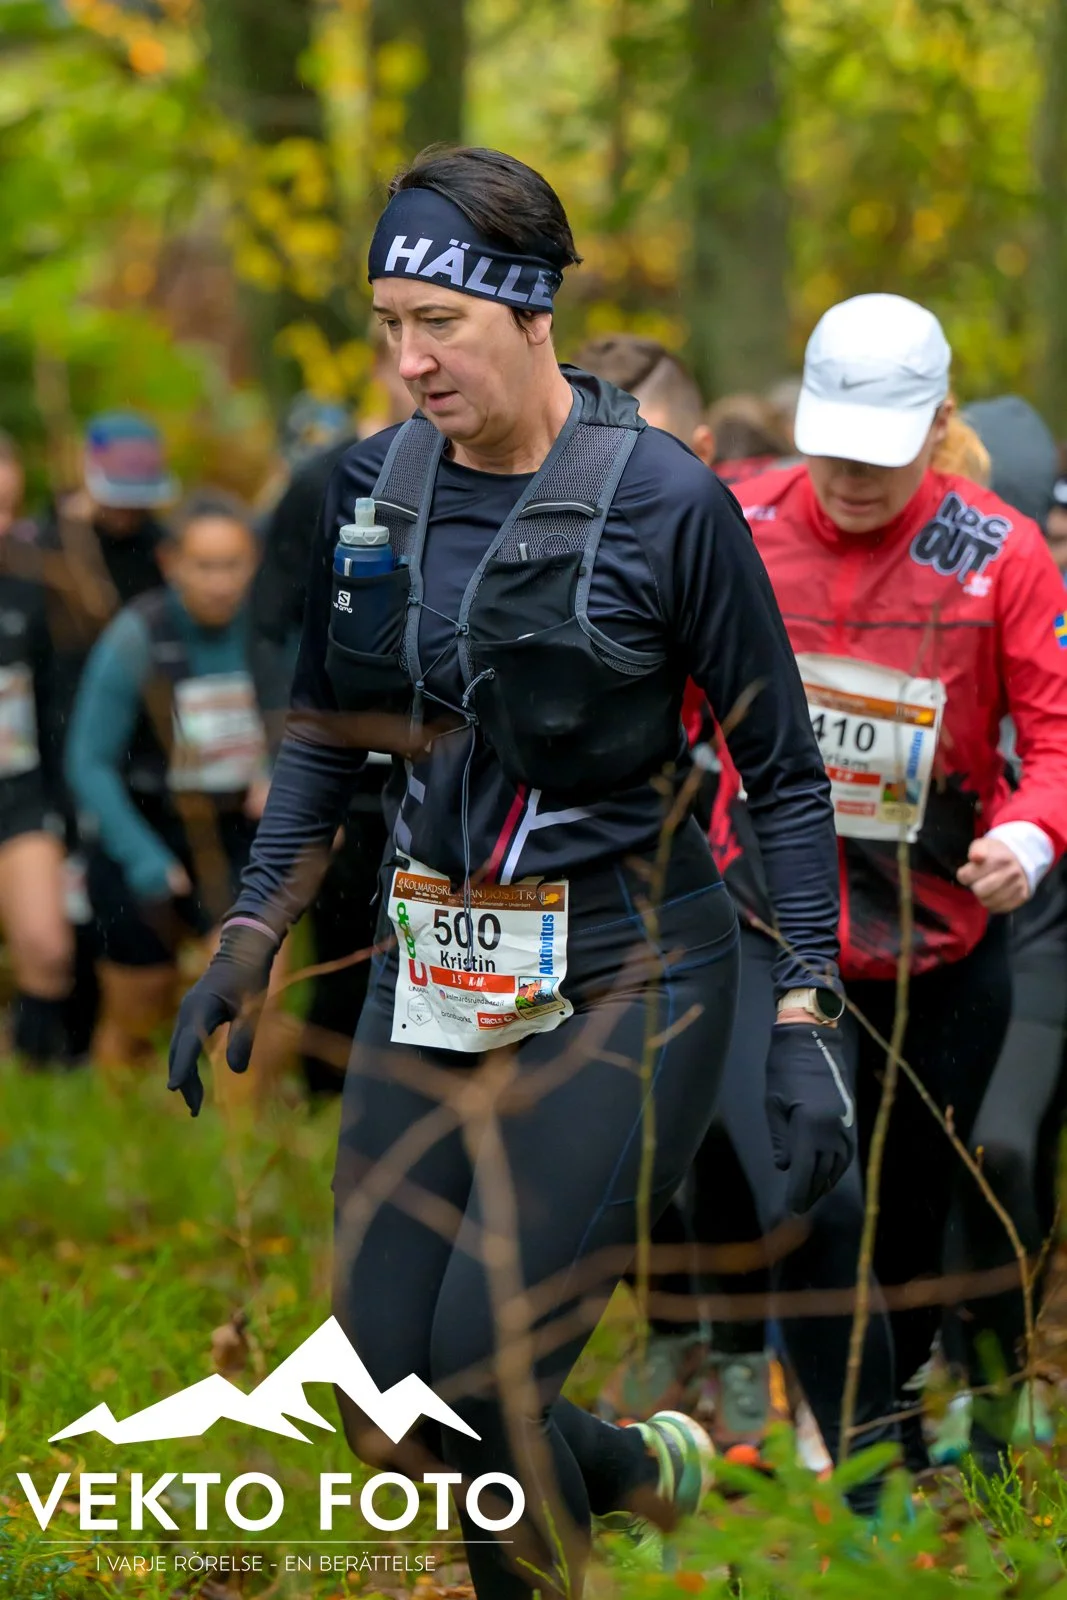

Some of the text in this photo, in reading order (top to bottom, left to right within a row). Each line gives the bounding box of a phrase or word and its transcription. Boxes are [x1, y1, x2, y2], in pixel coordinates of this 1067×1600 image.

[914, 520, 999, 572] OUT
[811, 713, 876, 752] 410
[434, 908, 501, 951] 500
[539, 914, 555, 976] Aktivitus
[440, 950, 496, 973] Kristin
